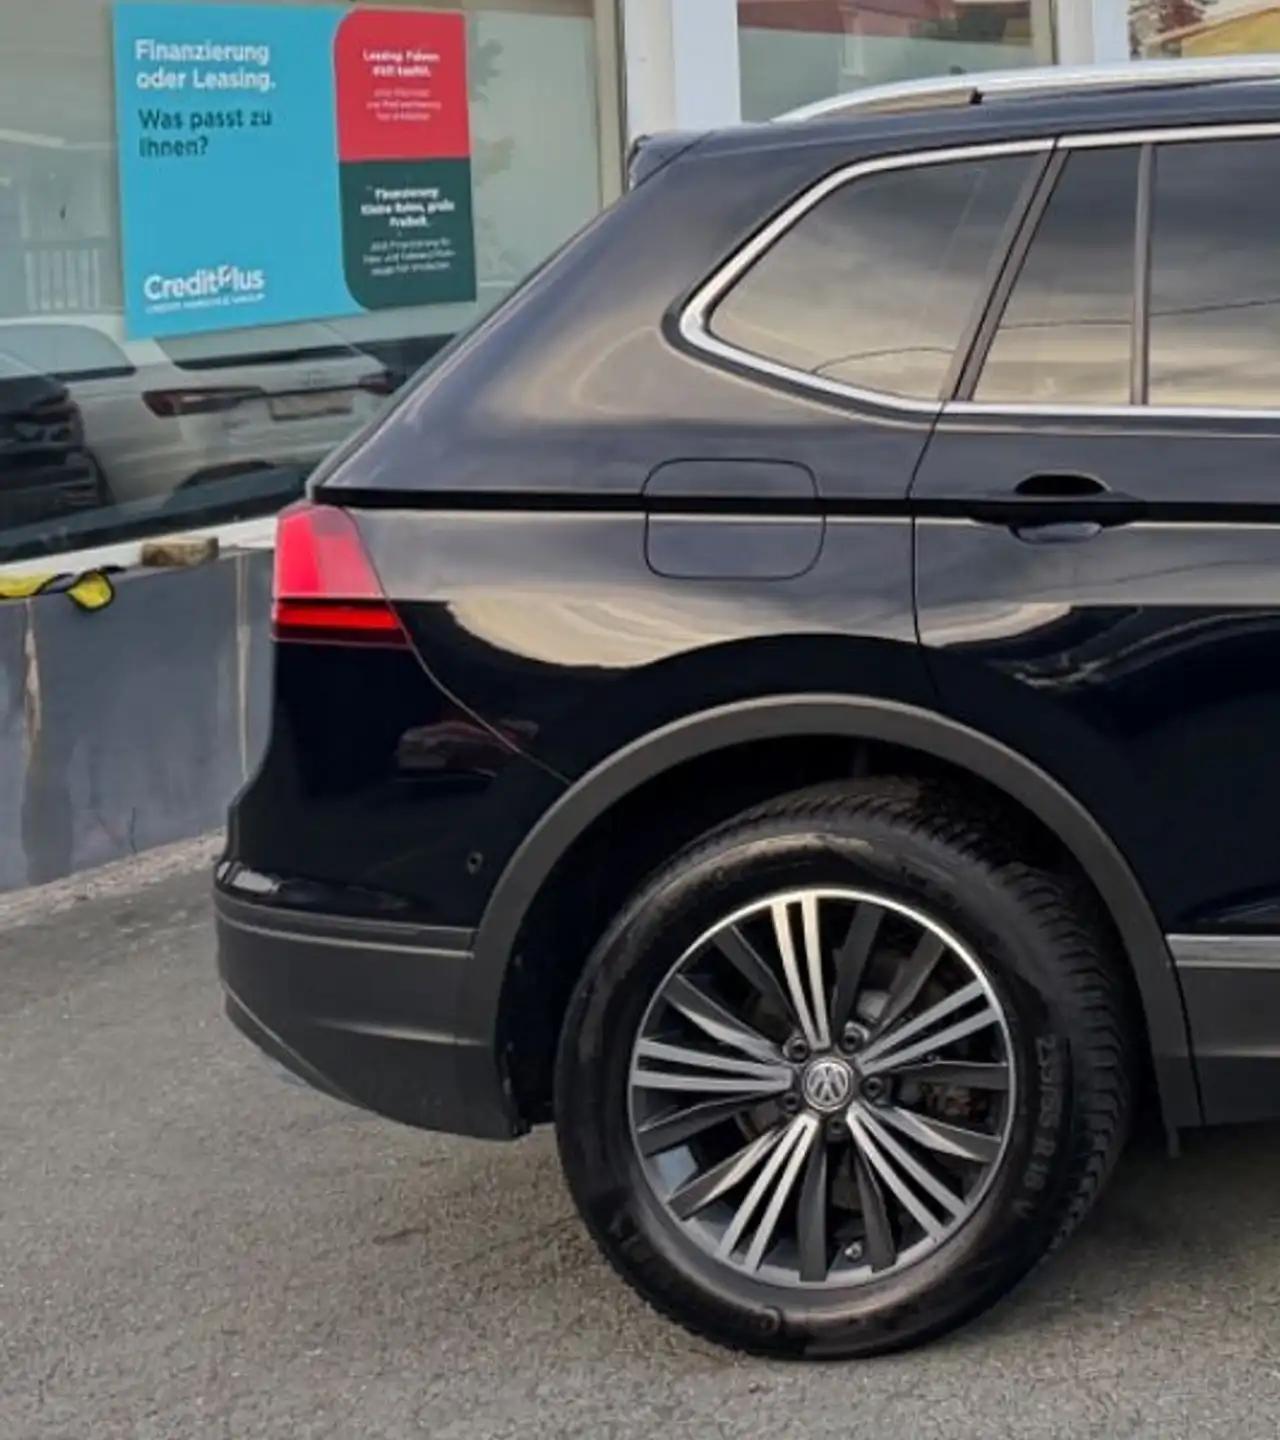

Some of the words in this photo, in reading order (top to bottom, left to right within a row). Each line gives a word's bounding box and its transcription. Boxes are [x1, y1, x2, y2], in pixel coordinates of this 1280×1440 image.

[135, 38, 270, 66] Finanzierung
[137, 67, 187, 90] oder
[193, 67, 276, 93] Leasing.
[138, 109, 183, 131] Was
[190, 109, 244, 131] passt
[250, 110, 272, 127] zu
[139, 136, 209, 157] Ihnen?
[144, 264, 266, 300] CreditPlus
